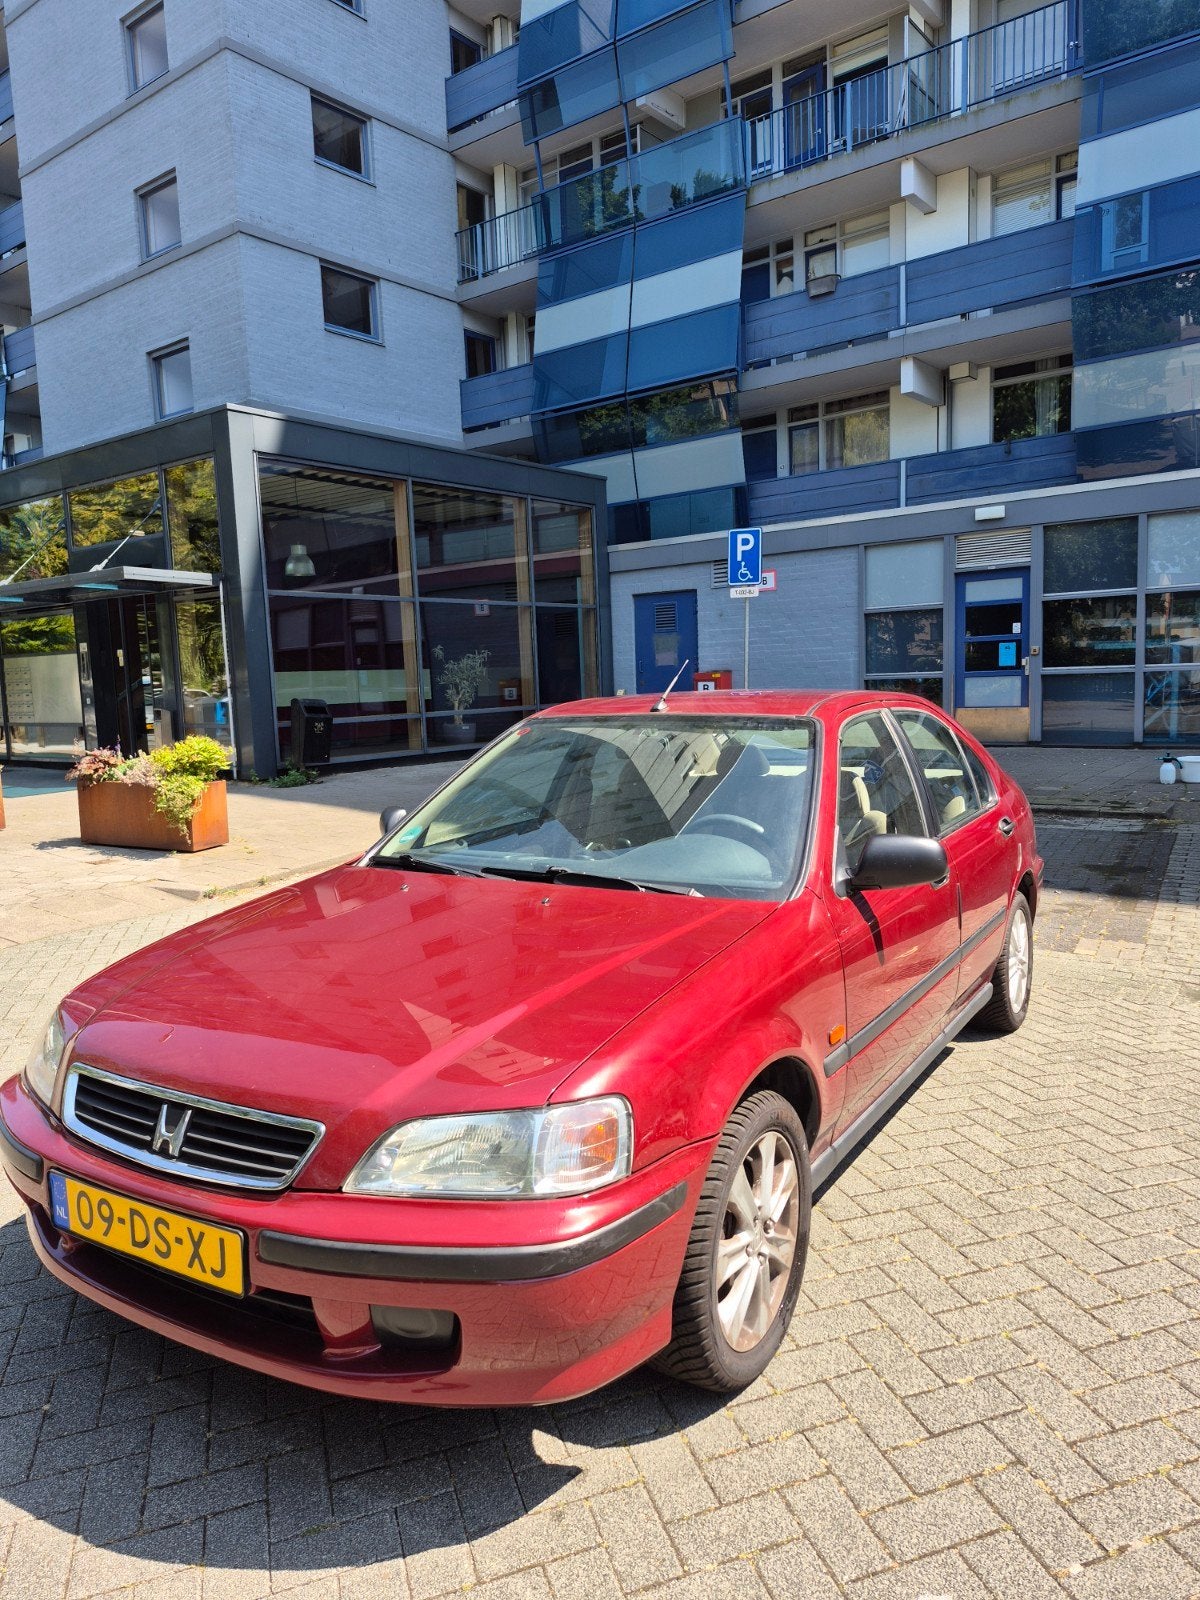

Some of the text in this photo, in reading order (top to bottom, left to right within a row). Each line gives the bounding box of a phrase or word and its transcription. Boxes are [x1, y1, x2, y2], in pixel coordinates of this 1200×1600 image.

[736, 533, 755, 561] P
[56, 1204, 68, 1219] NL
[76, 1190, 226, 1279] 09-DS-XJ
